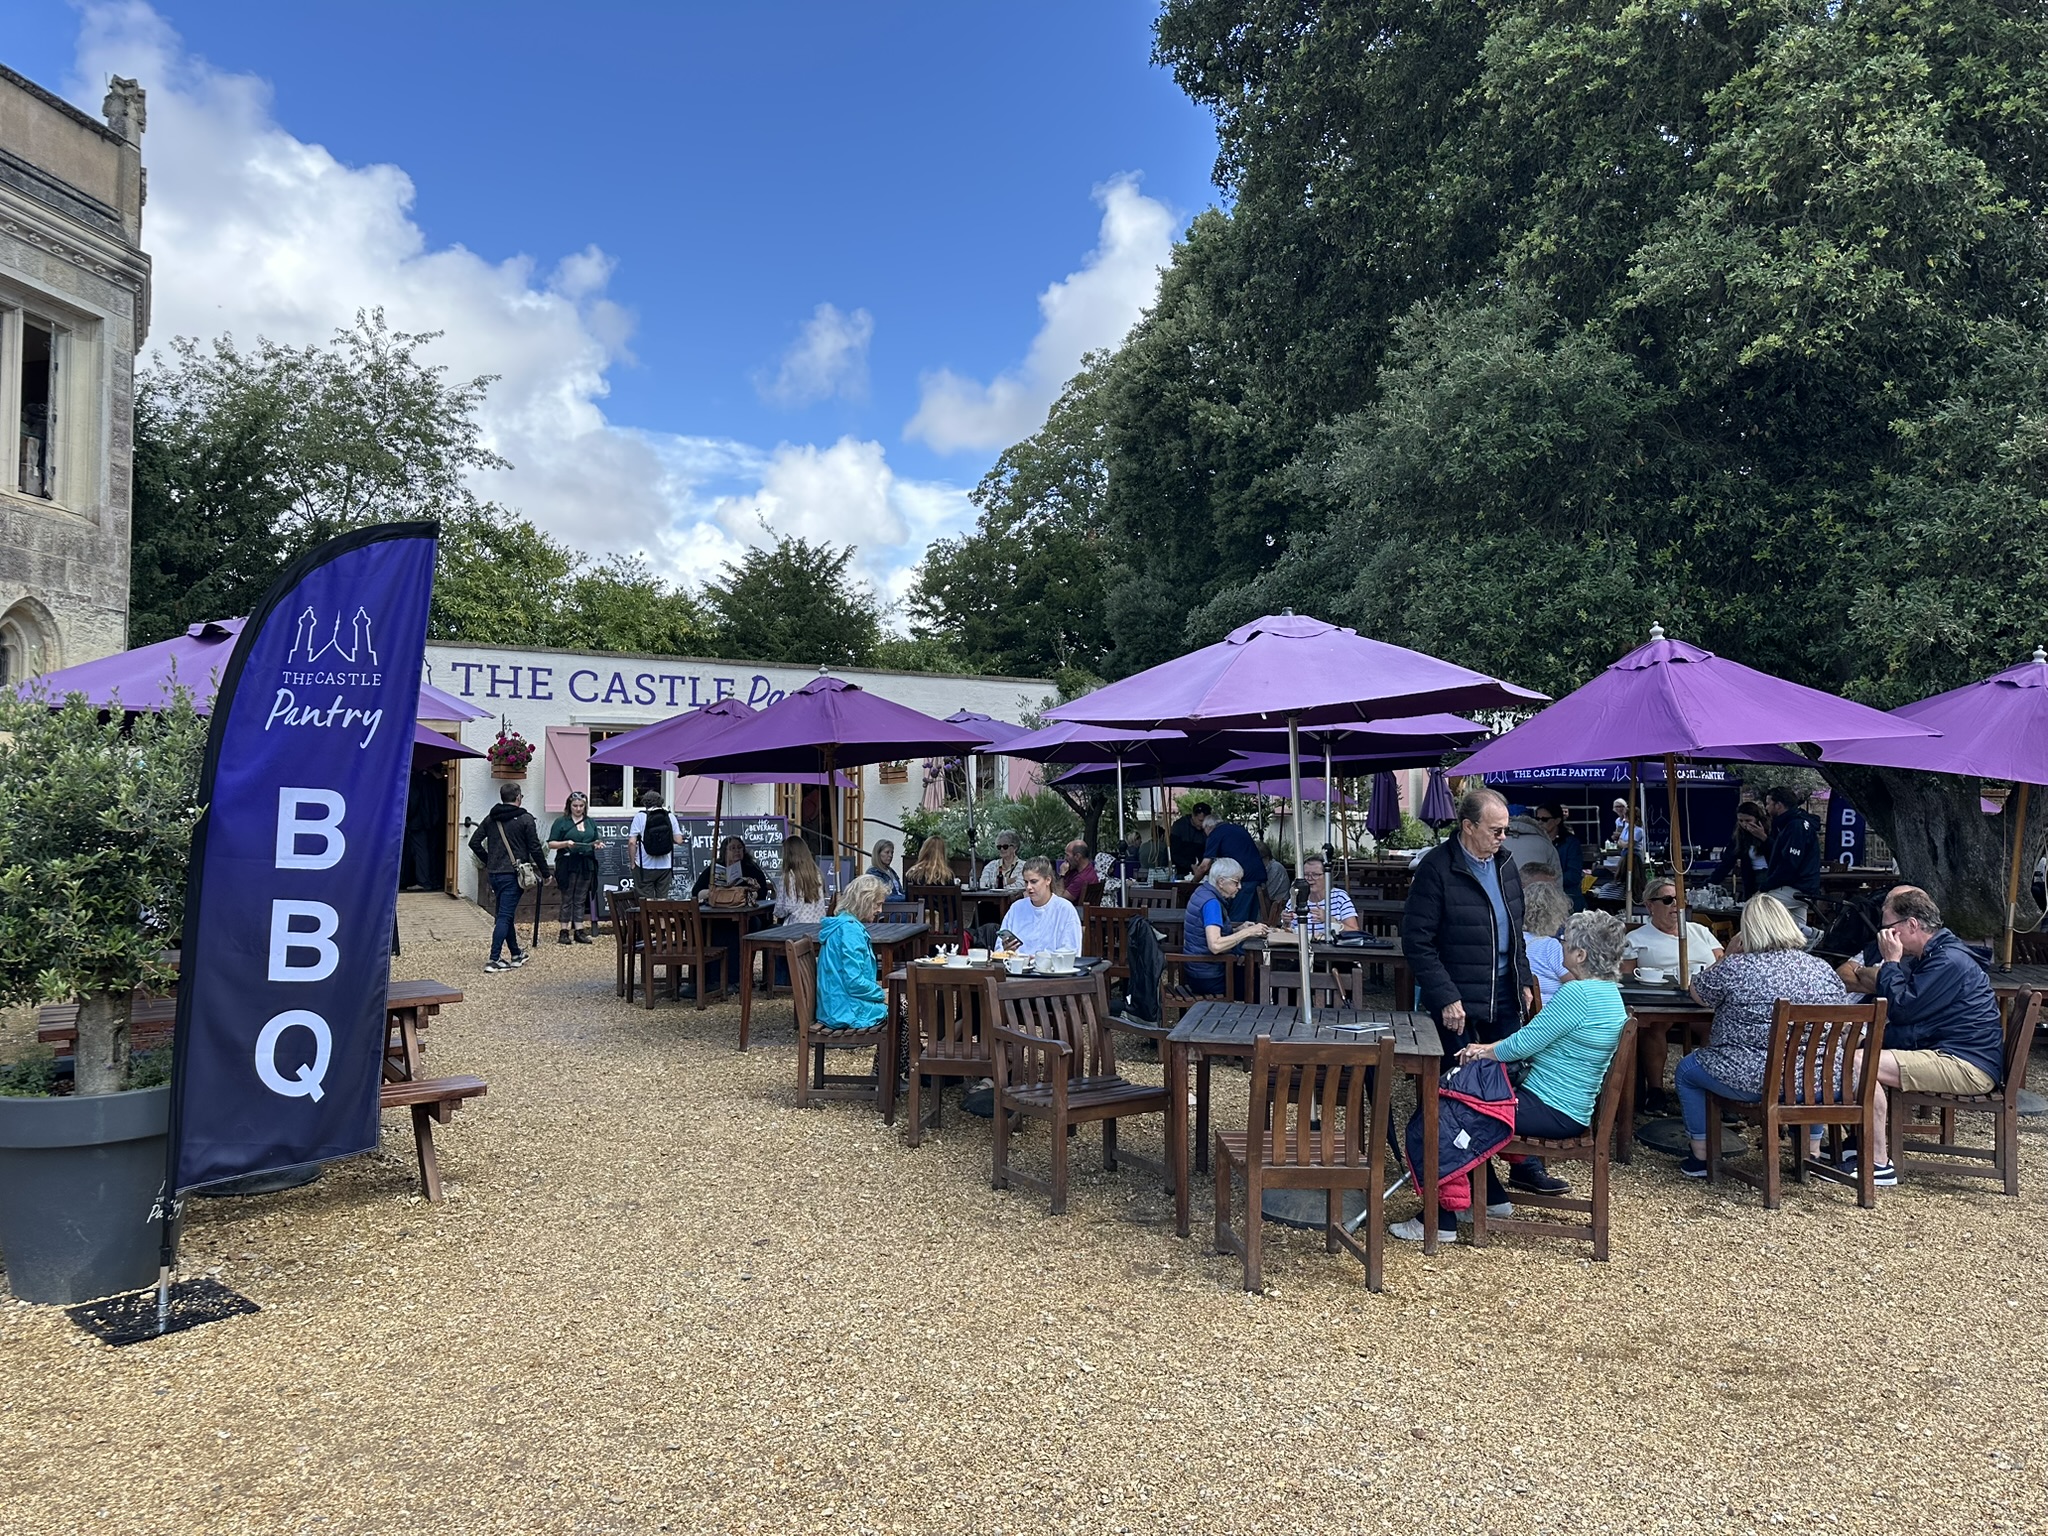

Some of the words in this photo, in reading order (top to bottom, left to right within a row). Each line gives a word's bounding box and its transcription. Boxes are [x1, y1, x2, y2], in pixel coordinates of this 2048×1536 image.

[451, 662, 553, 700] THE
[265, 688, 383, 749] Pantry
[1513, 770, 1532, 778] THE
[1533, 768, 1567, 778] CASTLE
[1568, 768, 1607, 777] PANTRY
[754, 850, 779, 859] CREAM
[255, 786, 346, 1103] BBQ
